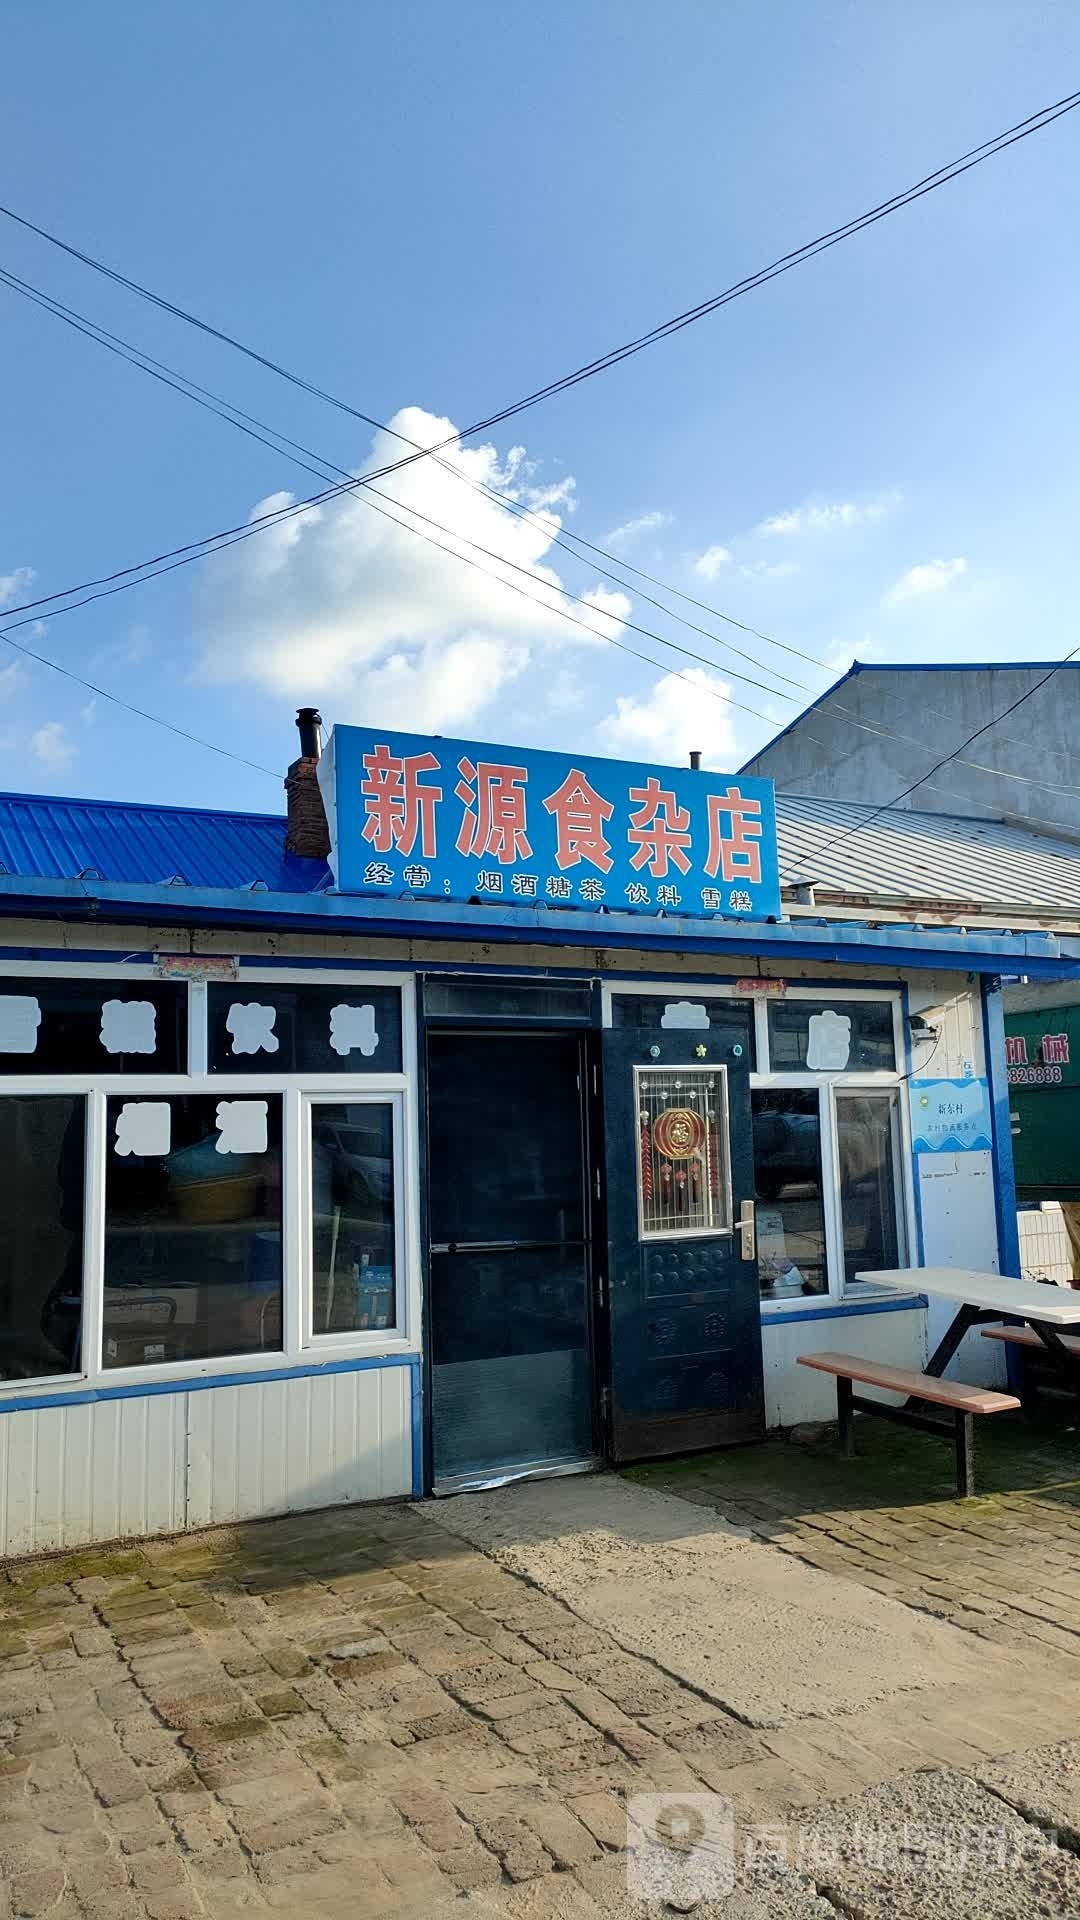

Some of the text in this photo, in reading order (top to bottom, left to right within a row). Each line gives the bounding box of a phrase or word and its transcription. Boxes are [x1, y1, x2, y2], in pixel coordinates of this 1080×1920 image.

[360, 744, 762, 884] 新源食杂店
[475, 872, 605, 902] 烟酒糖茶
[624, 882, 682, 905] 饮料
[701, 889, 753, 911] 雪糕
[1007, 1066, 1063, 1084] 826888
